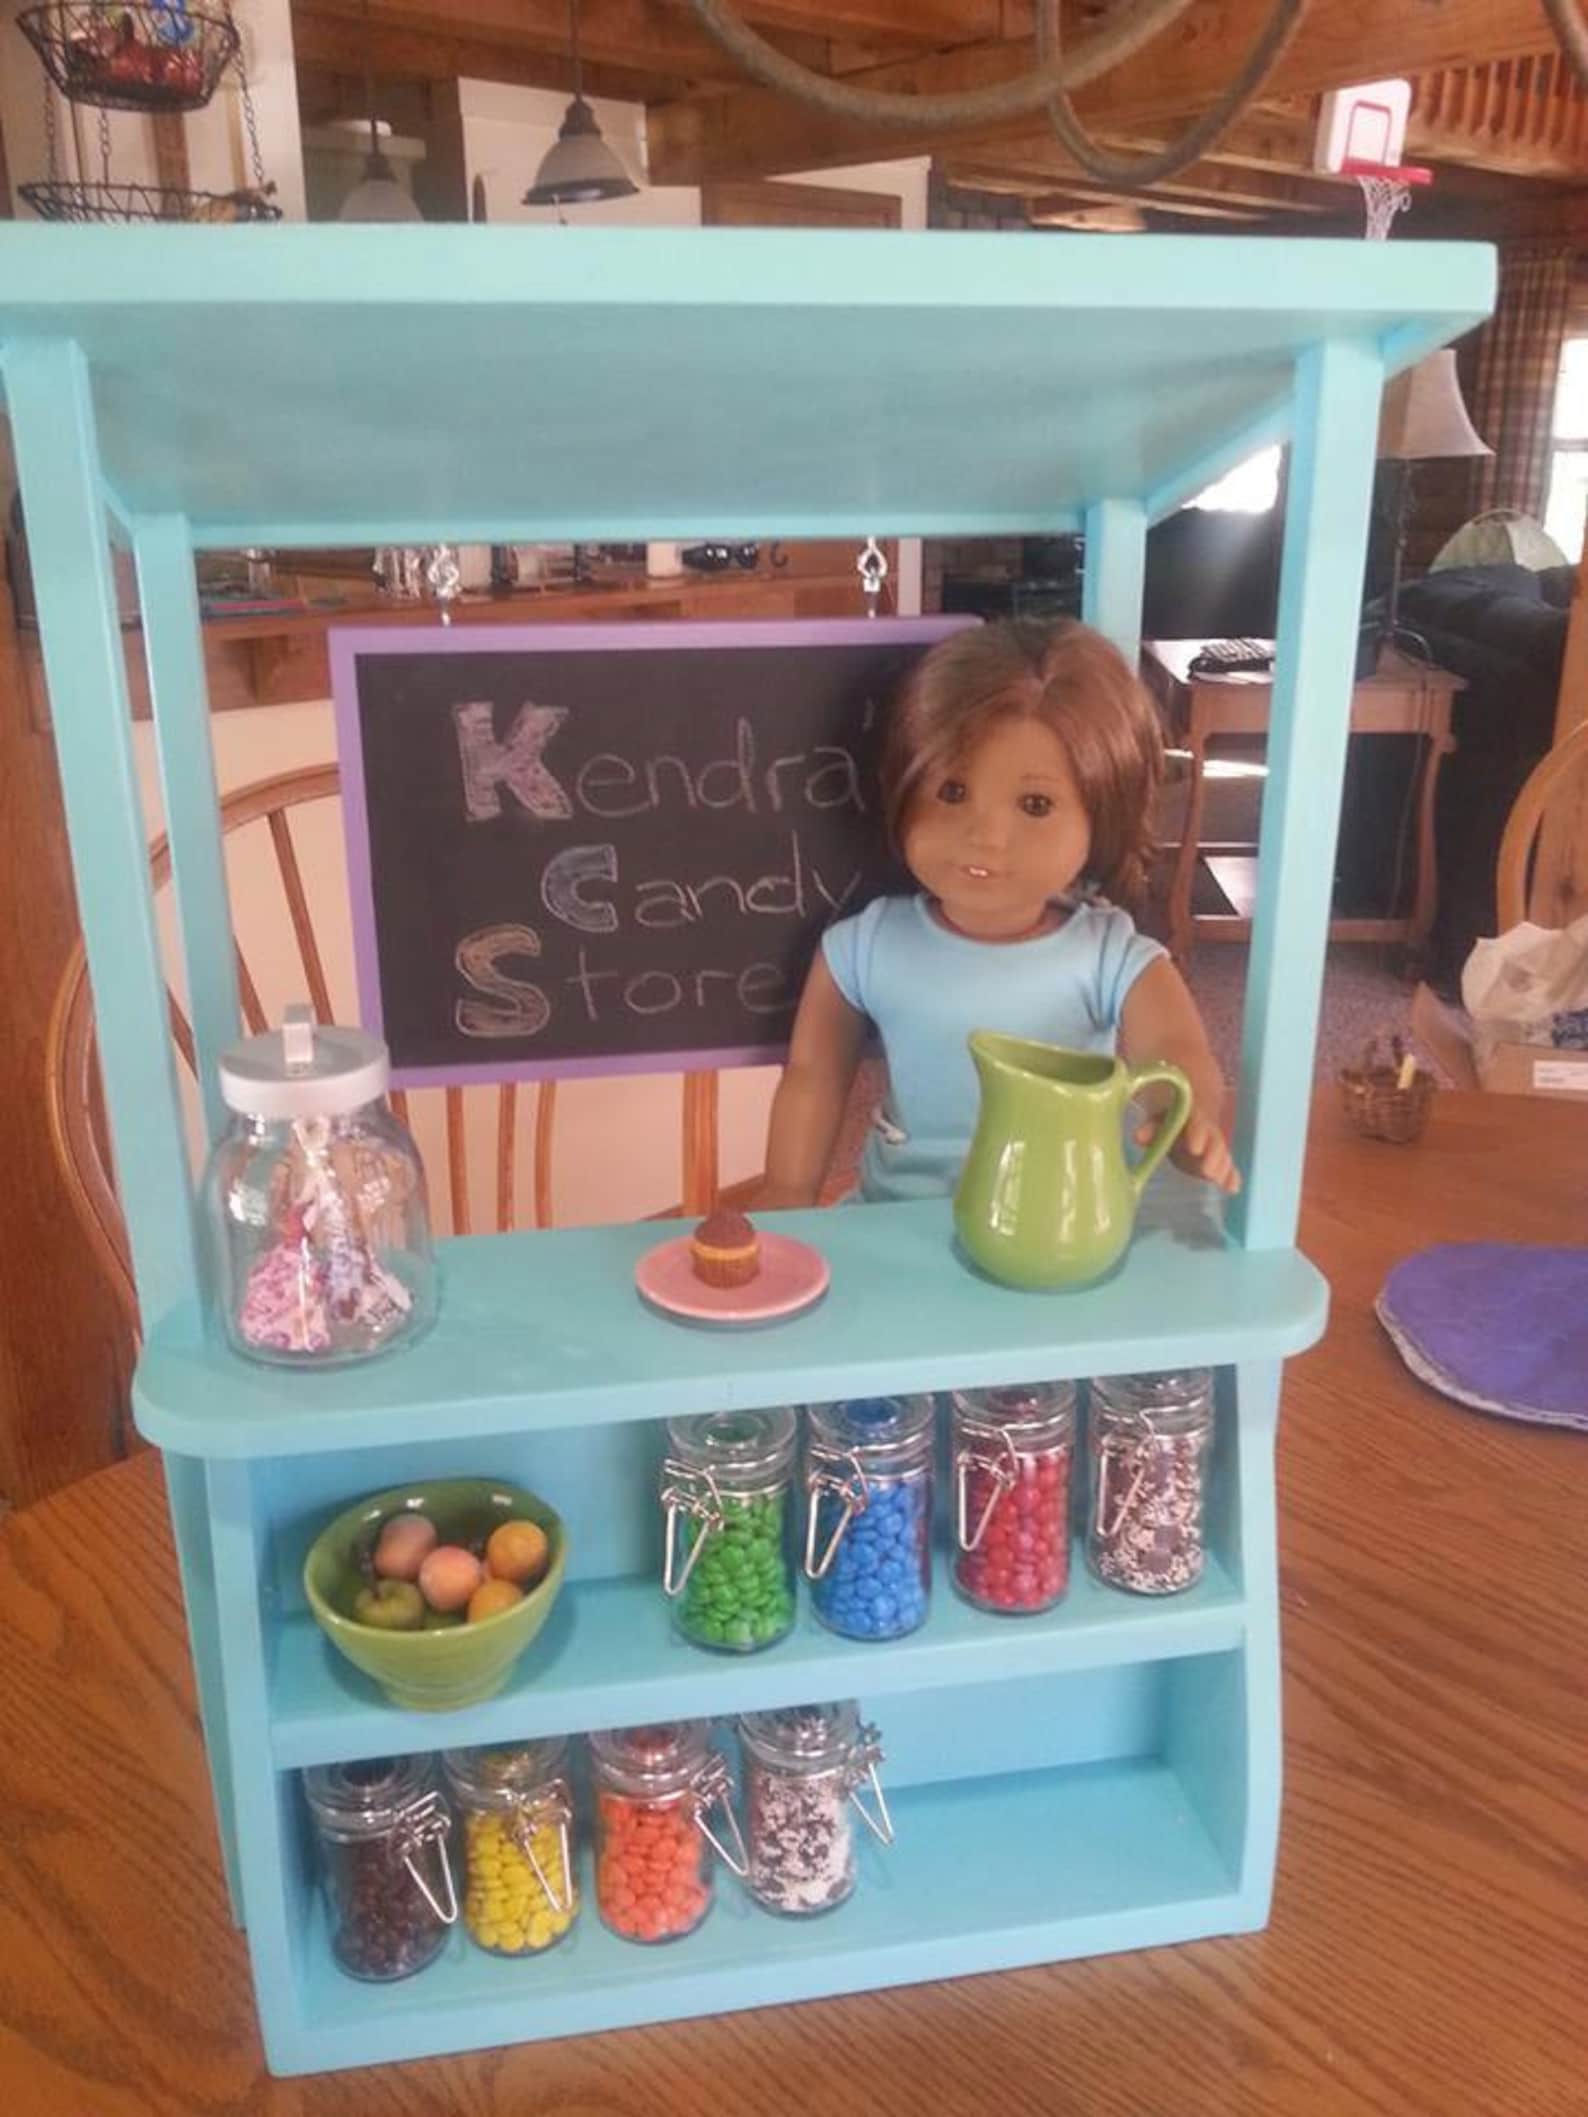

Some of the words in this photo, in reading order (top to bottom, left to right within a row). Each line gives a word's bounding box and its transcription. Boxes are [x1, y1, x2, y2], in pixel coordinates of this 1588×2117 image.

[452, 699, 875, 822] Kendra'
[540, 829, 864, 933] Candy
[454, 922, 788, 1038] Store
